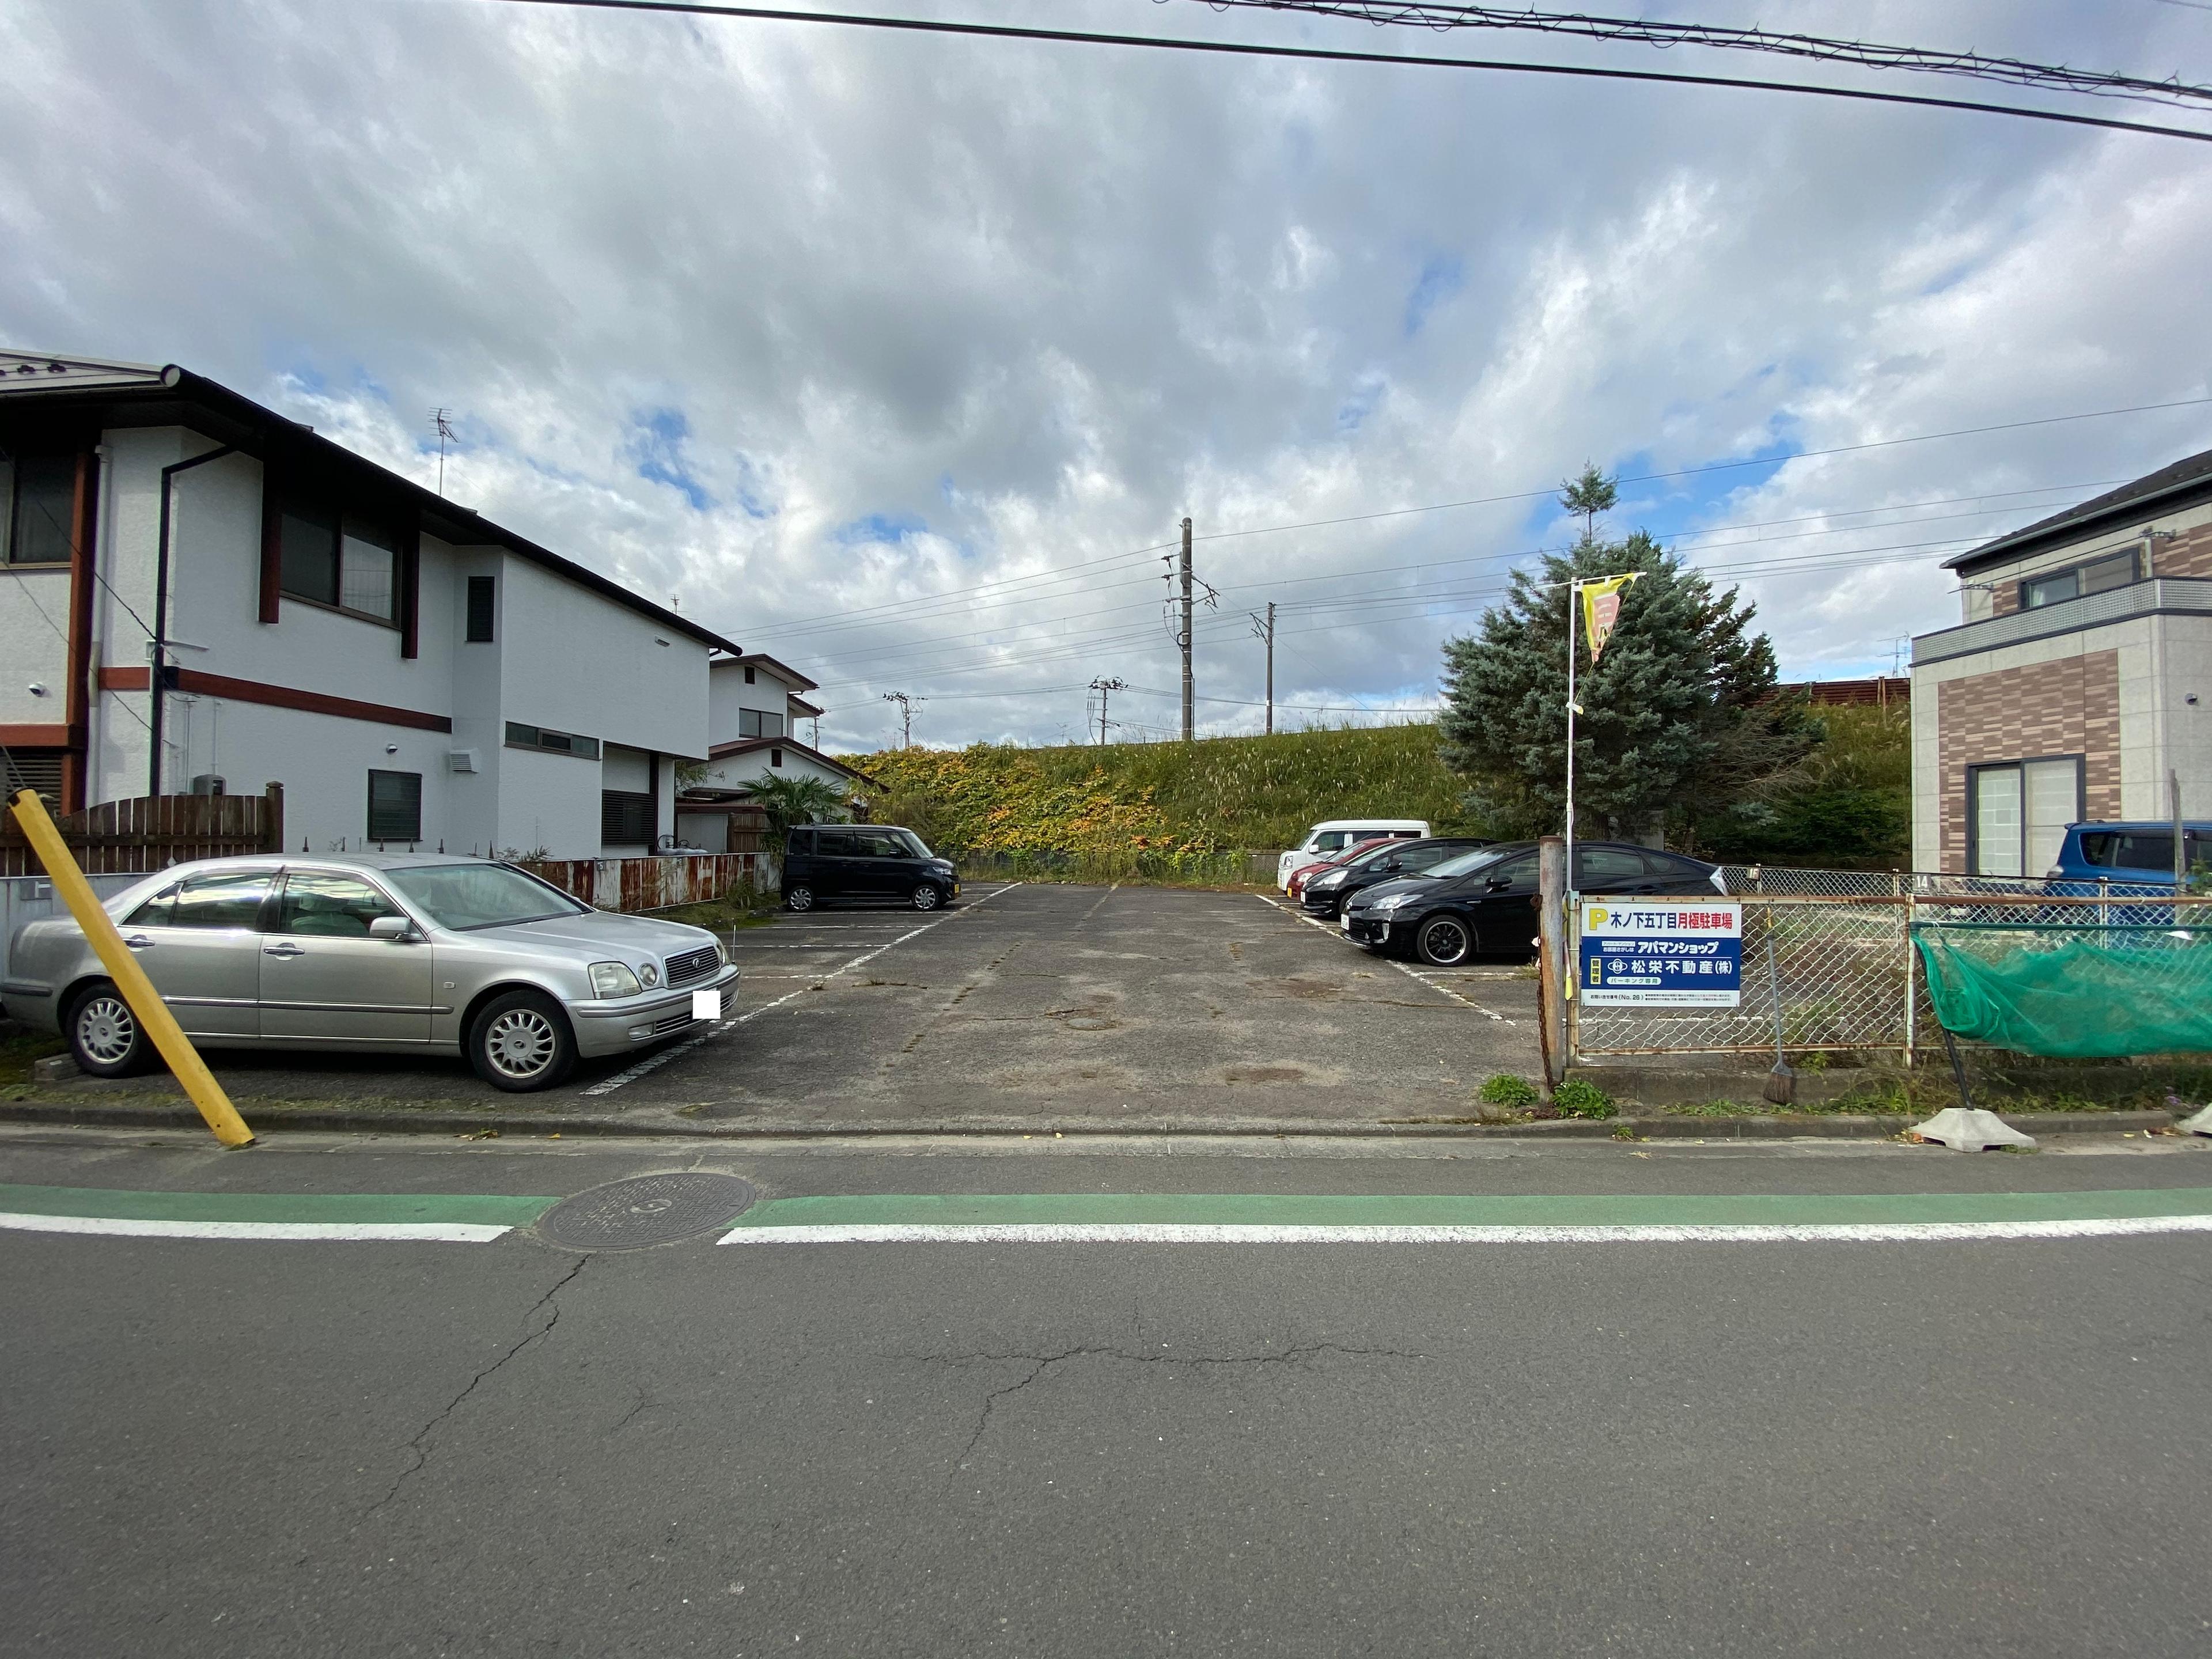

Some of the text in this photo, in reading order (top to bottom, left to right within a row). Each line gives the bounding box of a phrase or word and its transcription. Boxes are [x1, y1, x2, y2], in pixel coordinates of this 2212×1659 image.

[1916, 875, 1928, 888] 14
[1589, 908, 1733, 931] P 木ノ下五丁目月極駐車場
[1638, 940, 1719, 955] アパマンショップ
[1631, 960, 1733, 975] 松栄不動産(株)
